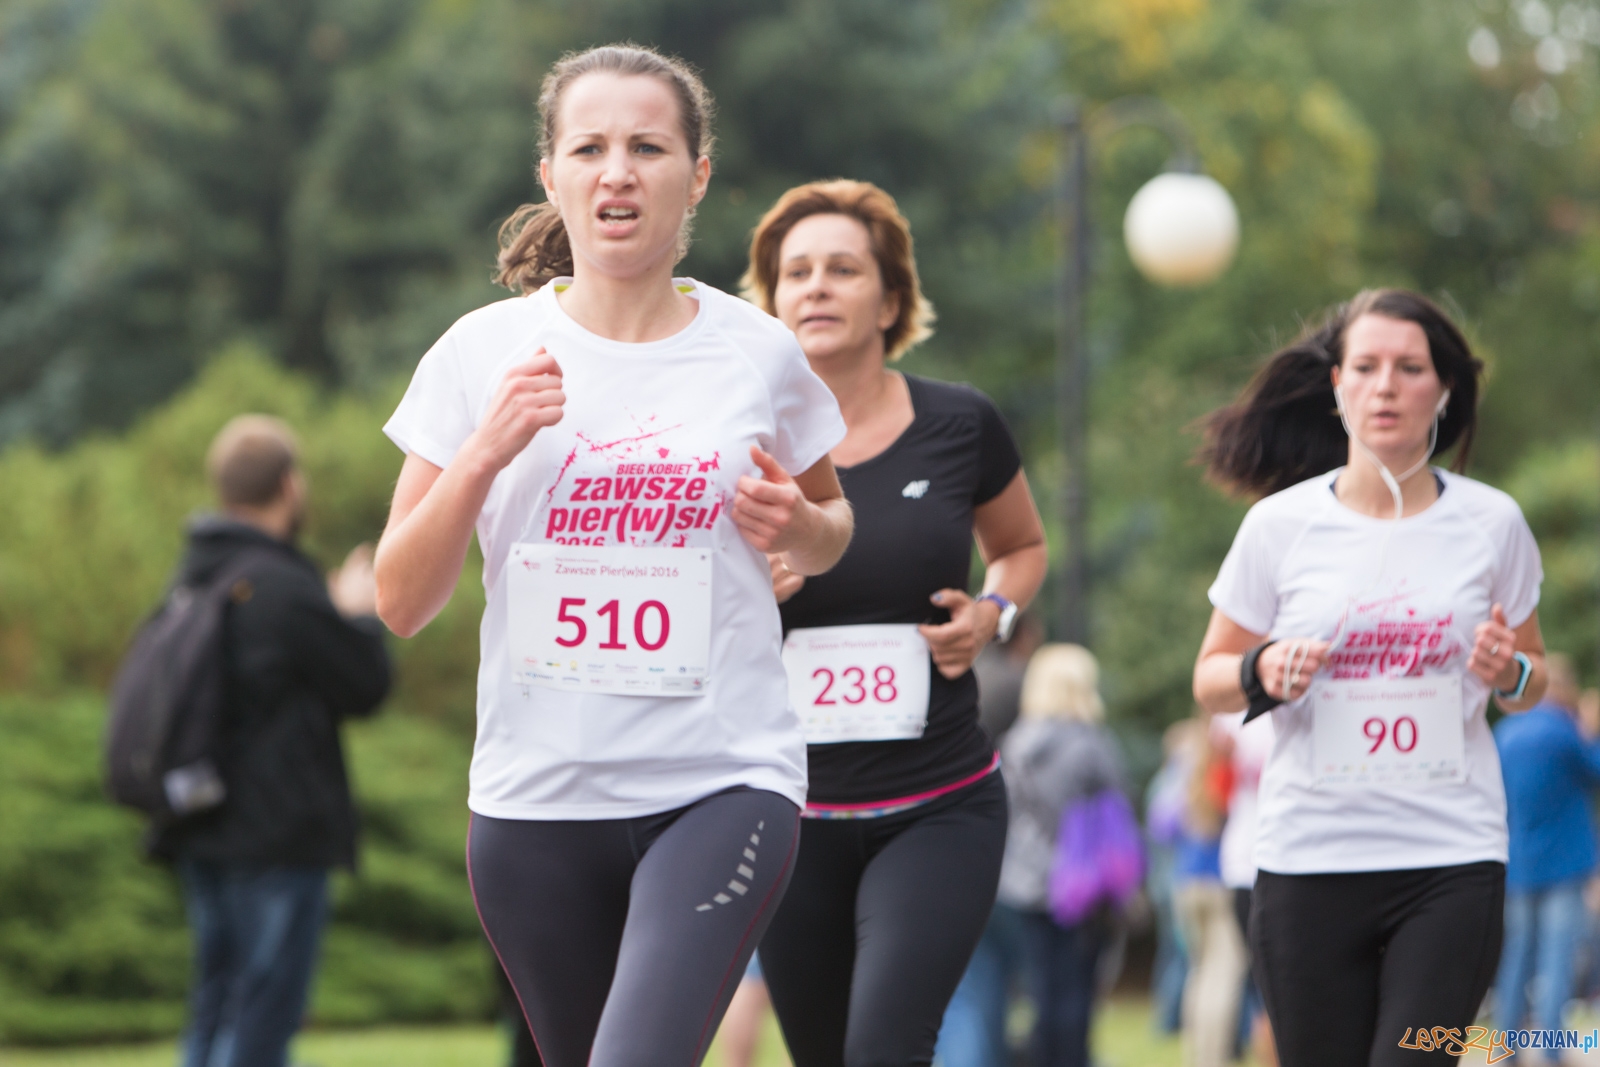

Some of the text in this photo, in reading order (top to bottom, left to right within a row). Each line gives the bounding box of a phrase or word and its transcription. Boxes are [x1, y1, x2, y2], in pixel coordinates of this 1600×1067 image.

[616, 463, 693, 475] BIEG KOBIET
[569, 476, 707, 502] zawsze
[901, 479, 931, 499] 4F
[545, 502, 721, 543] pier(w)si!
[555, 563, 596, 576] Zawsze
[600, 564, 647, 579] Pier(w)si
[651, 566, 679, 577] 2016
[555, 597, 670, 651] 510
[813, 666, 897, 705] 238
[1363, 716, 1418, 754] 90
